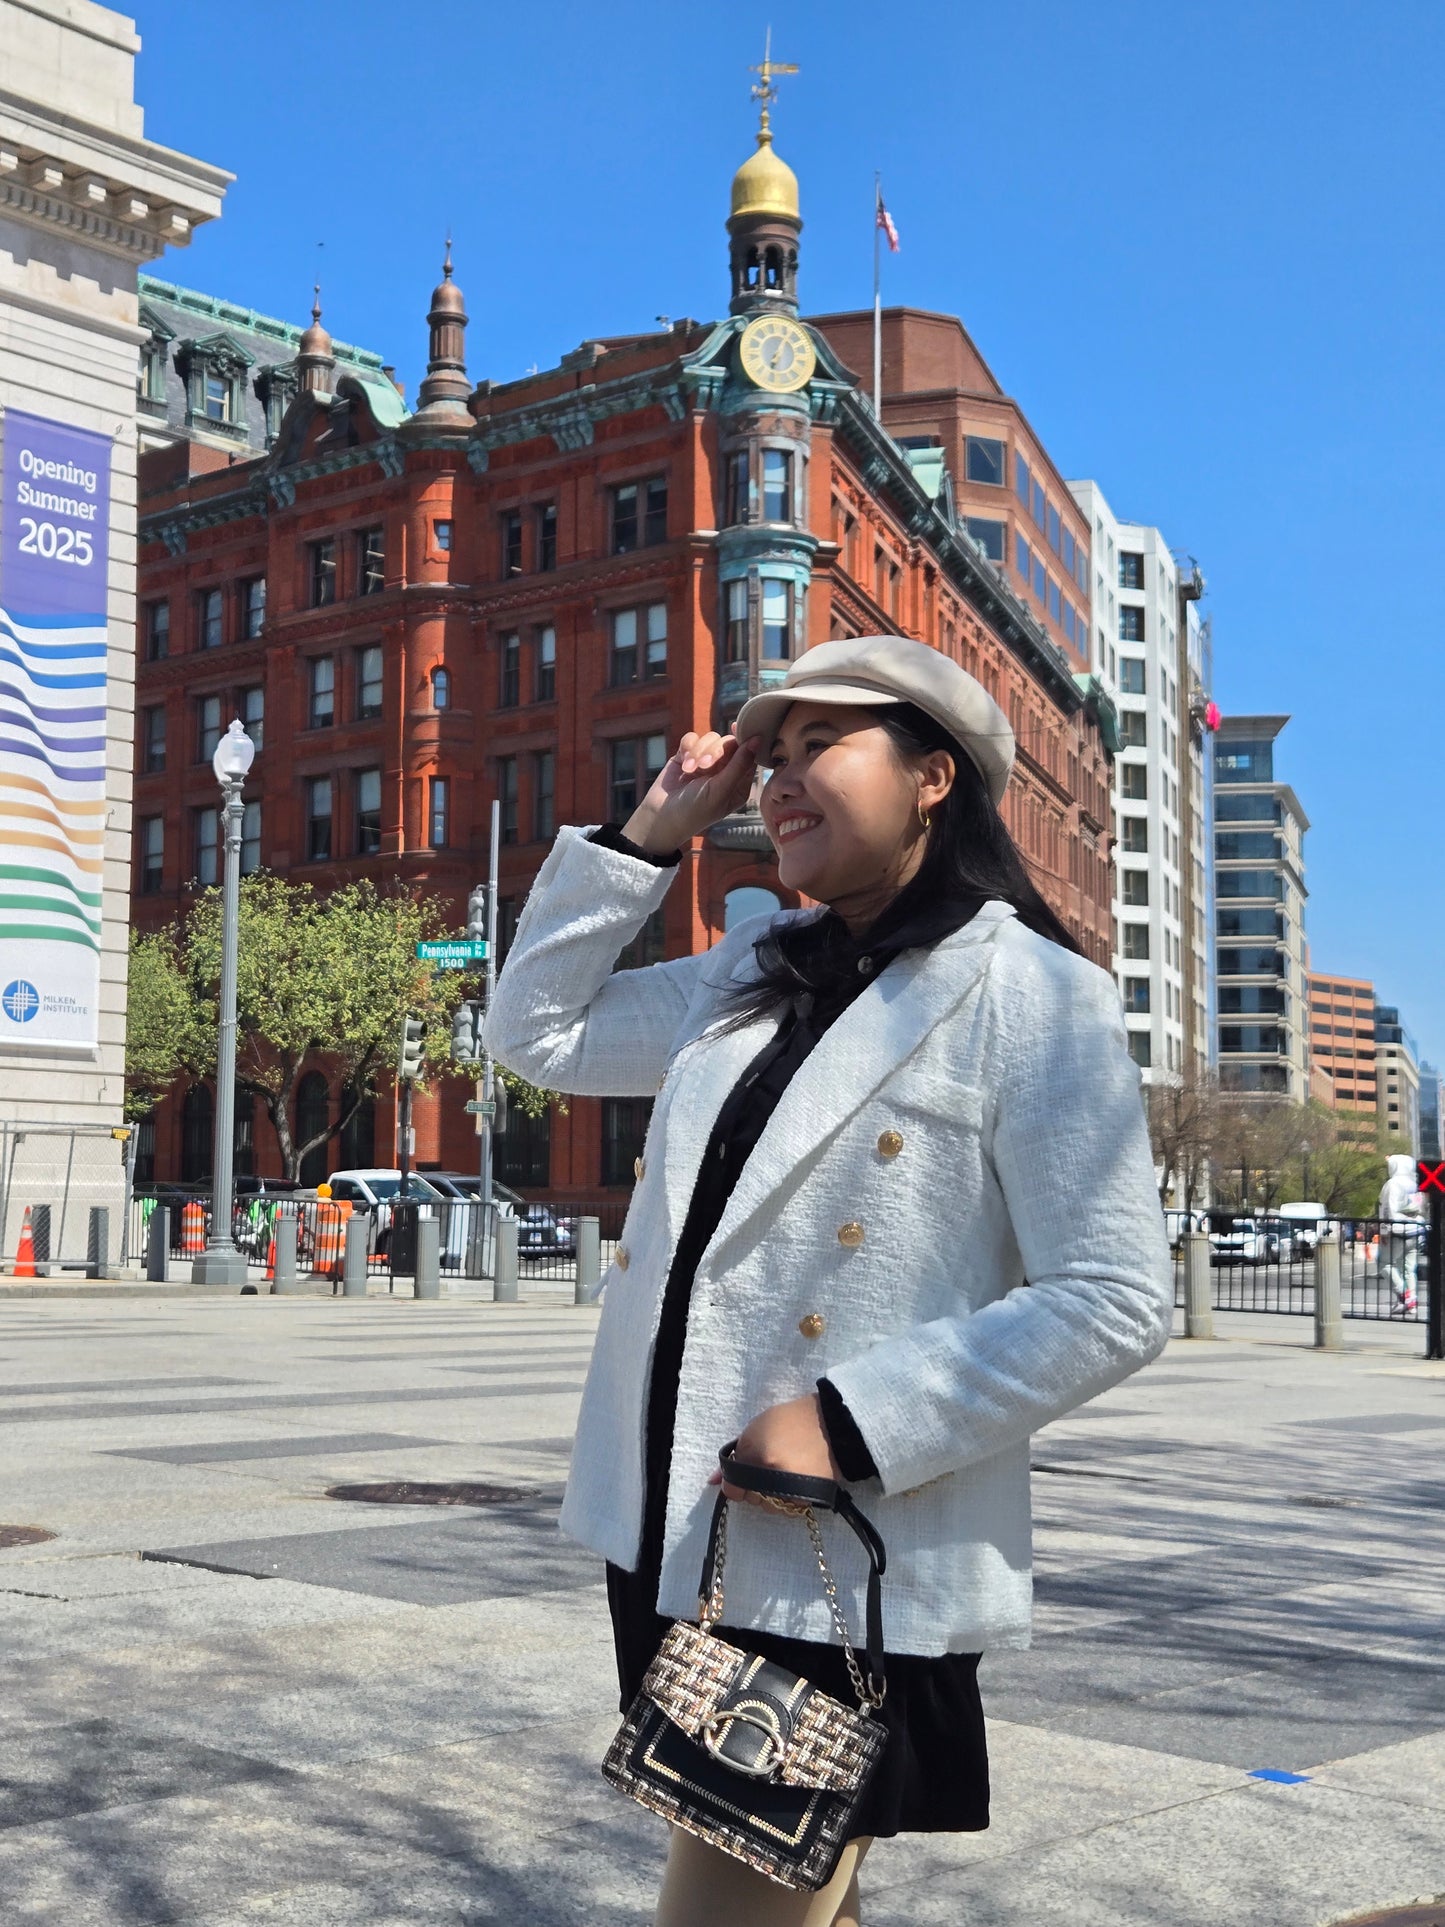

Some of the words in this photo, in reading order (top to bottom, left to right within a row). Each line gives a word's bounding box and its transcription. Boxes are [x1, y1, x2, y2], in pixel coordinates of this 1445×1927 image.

[19, 449, 97, 493] Opening
[17, 481, 98, 521] Summer
[18, 517, 94, 566] 2025
[422, 943, 472, 958] Pennsylvania
[440, 958, 464, 968] 1500
[43, 995, 76, 1005] MILKEN
[43, 1004, 89, 1015] INSTITUTE
